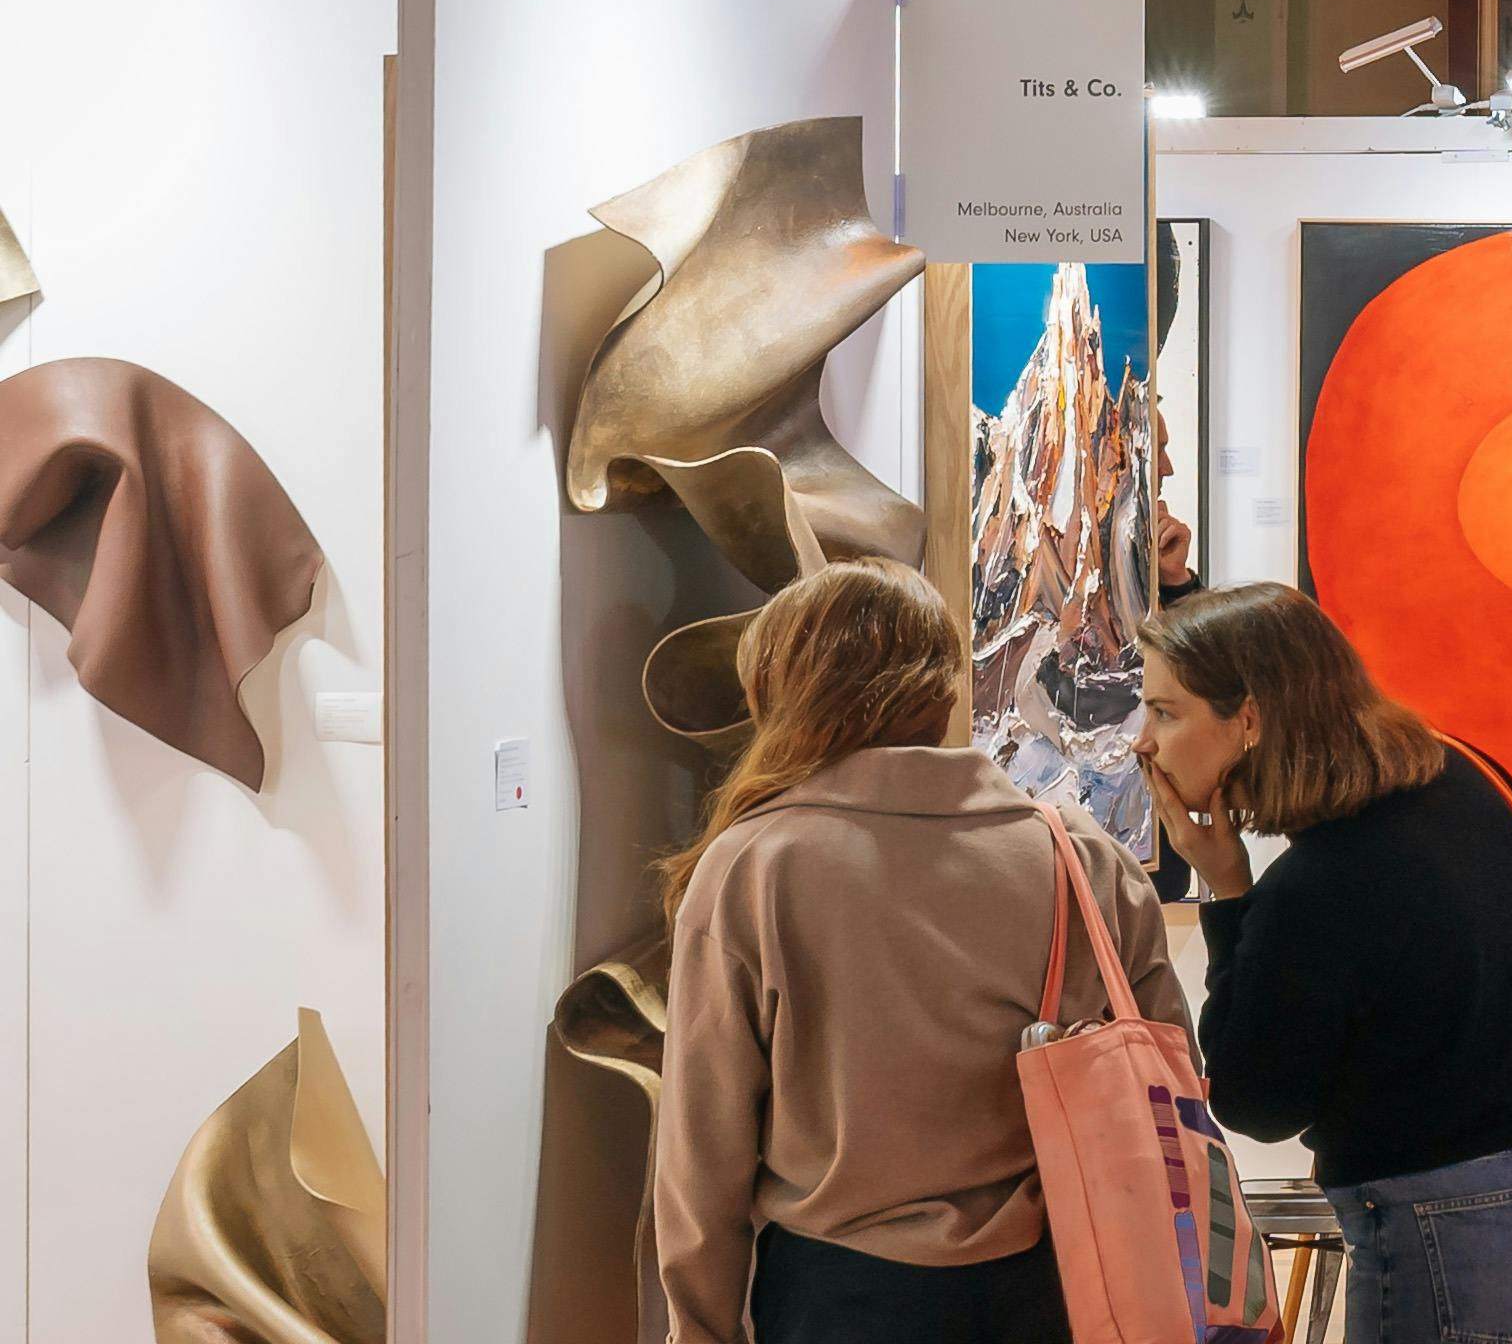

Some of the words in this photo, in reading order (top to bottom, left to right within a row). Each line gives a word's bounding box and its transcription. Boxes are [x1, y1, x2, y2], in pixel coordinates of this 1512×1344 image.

[1020, 79, 1055, 97] Tits
[1064, 79, 1079, 97] &
[1087, 79, 1122, 97] Co.
[957, 201, 1047, 218] Melbourne,
[1053, 201, 1122, 216] Australia
[1005, 229, 1041, 243] New
[1047, 228, 1084, 245] York,
[1090, 229, 1122, 243] USA
